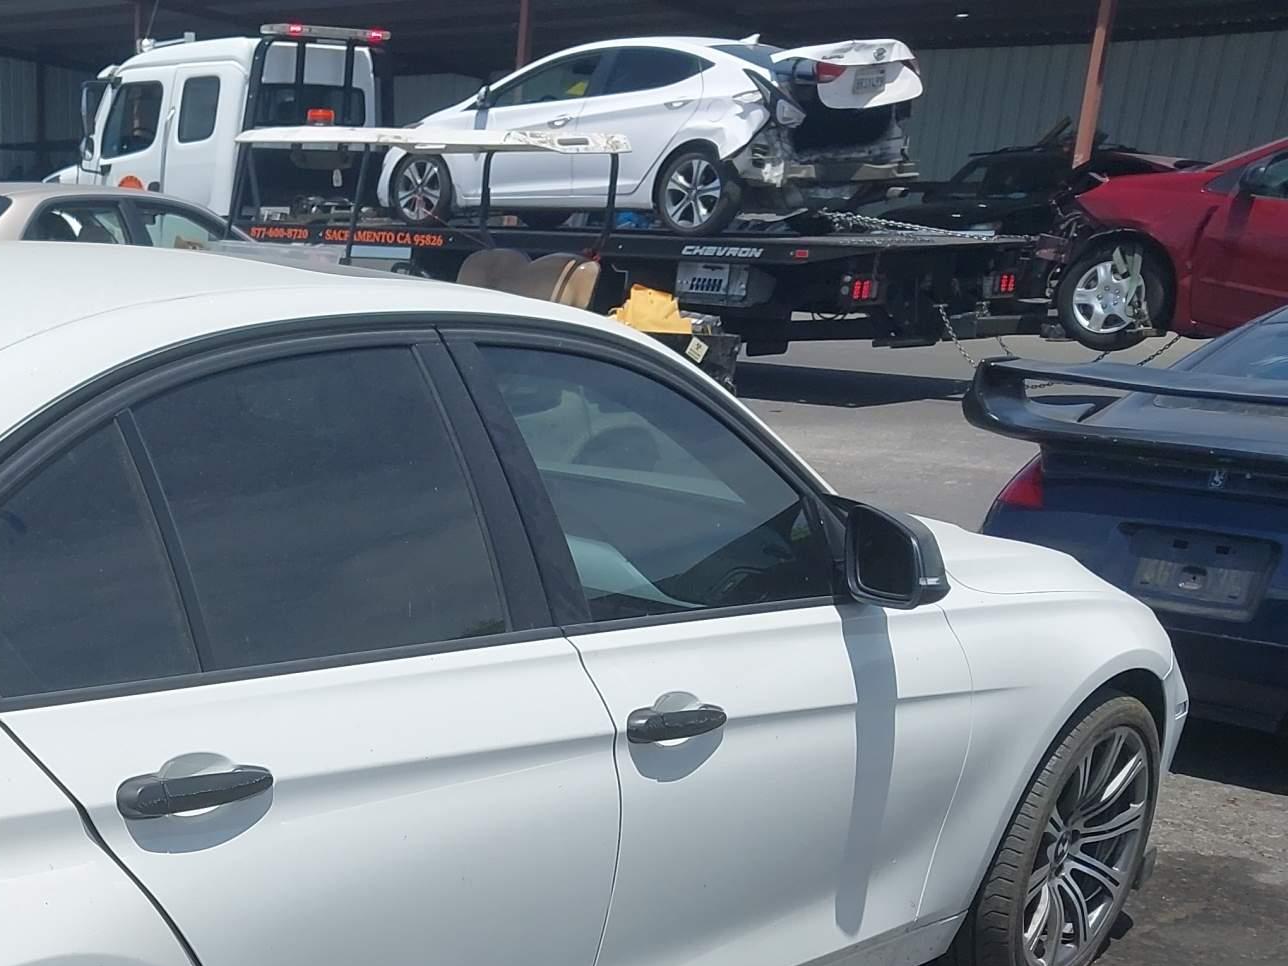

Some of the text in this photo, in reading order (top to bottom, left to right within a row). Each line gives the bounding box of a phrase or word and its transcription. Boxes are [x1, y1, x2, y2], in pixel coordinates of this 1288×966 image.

[396, 232, 412, 244] CA
[413, 233, 443, 246] 95826
[681, 245, 764, 258] CHEVRON
